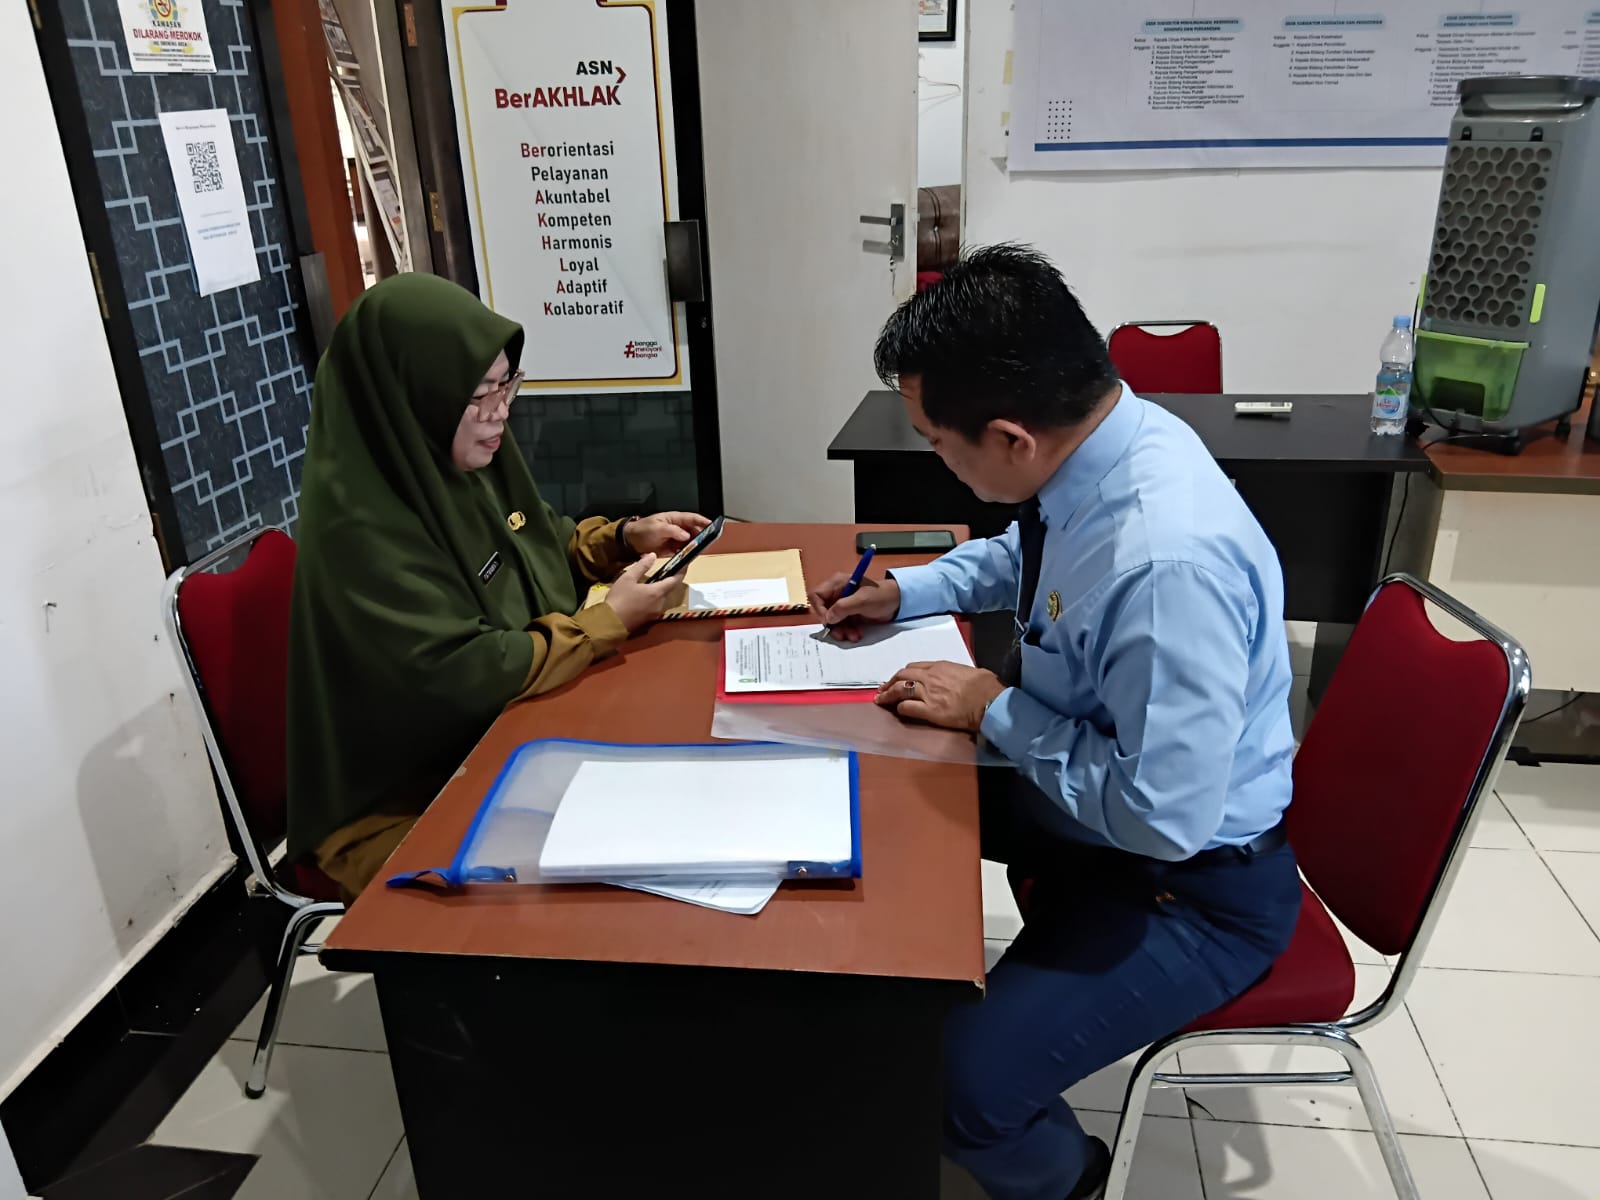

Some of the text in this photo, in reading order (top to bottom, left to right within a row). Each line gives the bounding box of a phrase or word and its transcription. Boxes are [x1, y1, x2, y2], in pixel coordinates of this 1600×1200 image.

[132, 28, 203, 41] DILARANG MEROKOK
[576, 60, 613, 76] ASN
[495, 85, 621, 109] BerAKHLAK
[521, 141, 614, 158] Berorientasi
[531, 166, 608, 184] Pelayanan
[536, 188, 610, 205] Akuntabel
[538, 212, 612, 230] Kompeten
[542, 234, 612, 250] Harmonis
[560, 257, 599, 275] Loyal
[556, 279, 607, 297] Adaptif
[544, 300, 624, 316] Kolaboratif
